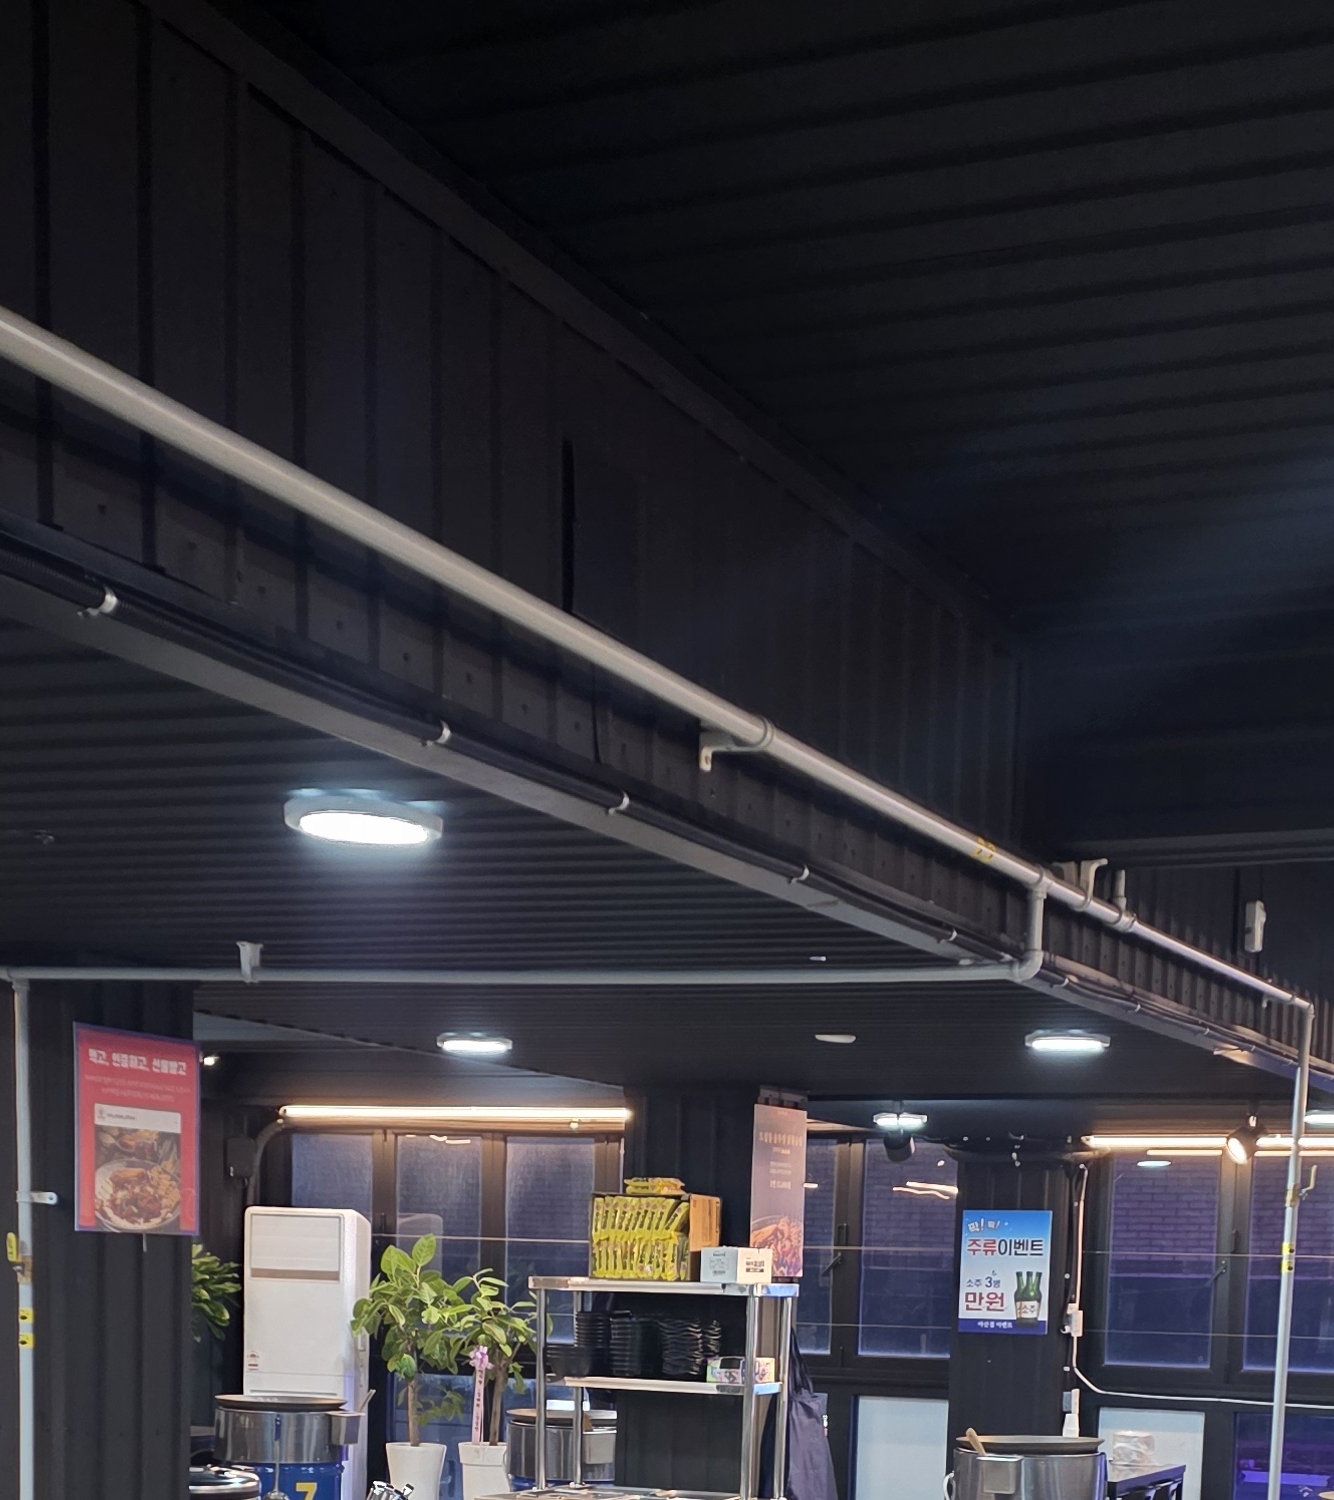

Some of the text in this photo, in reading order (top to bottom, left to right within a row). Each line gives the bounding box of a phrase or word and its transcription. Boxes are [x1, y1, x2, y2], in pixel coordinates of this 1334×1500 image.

[967, 1238, 1044, 1257] 주류이벤트
[966, 1276, 1001, 1289] 소주 3병
[964, 1291, 1005, 1312] 만원
